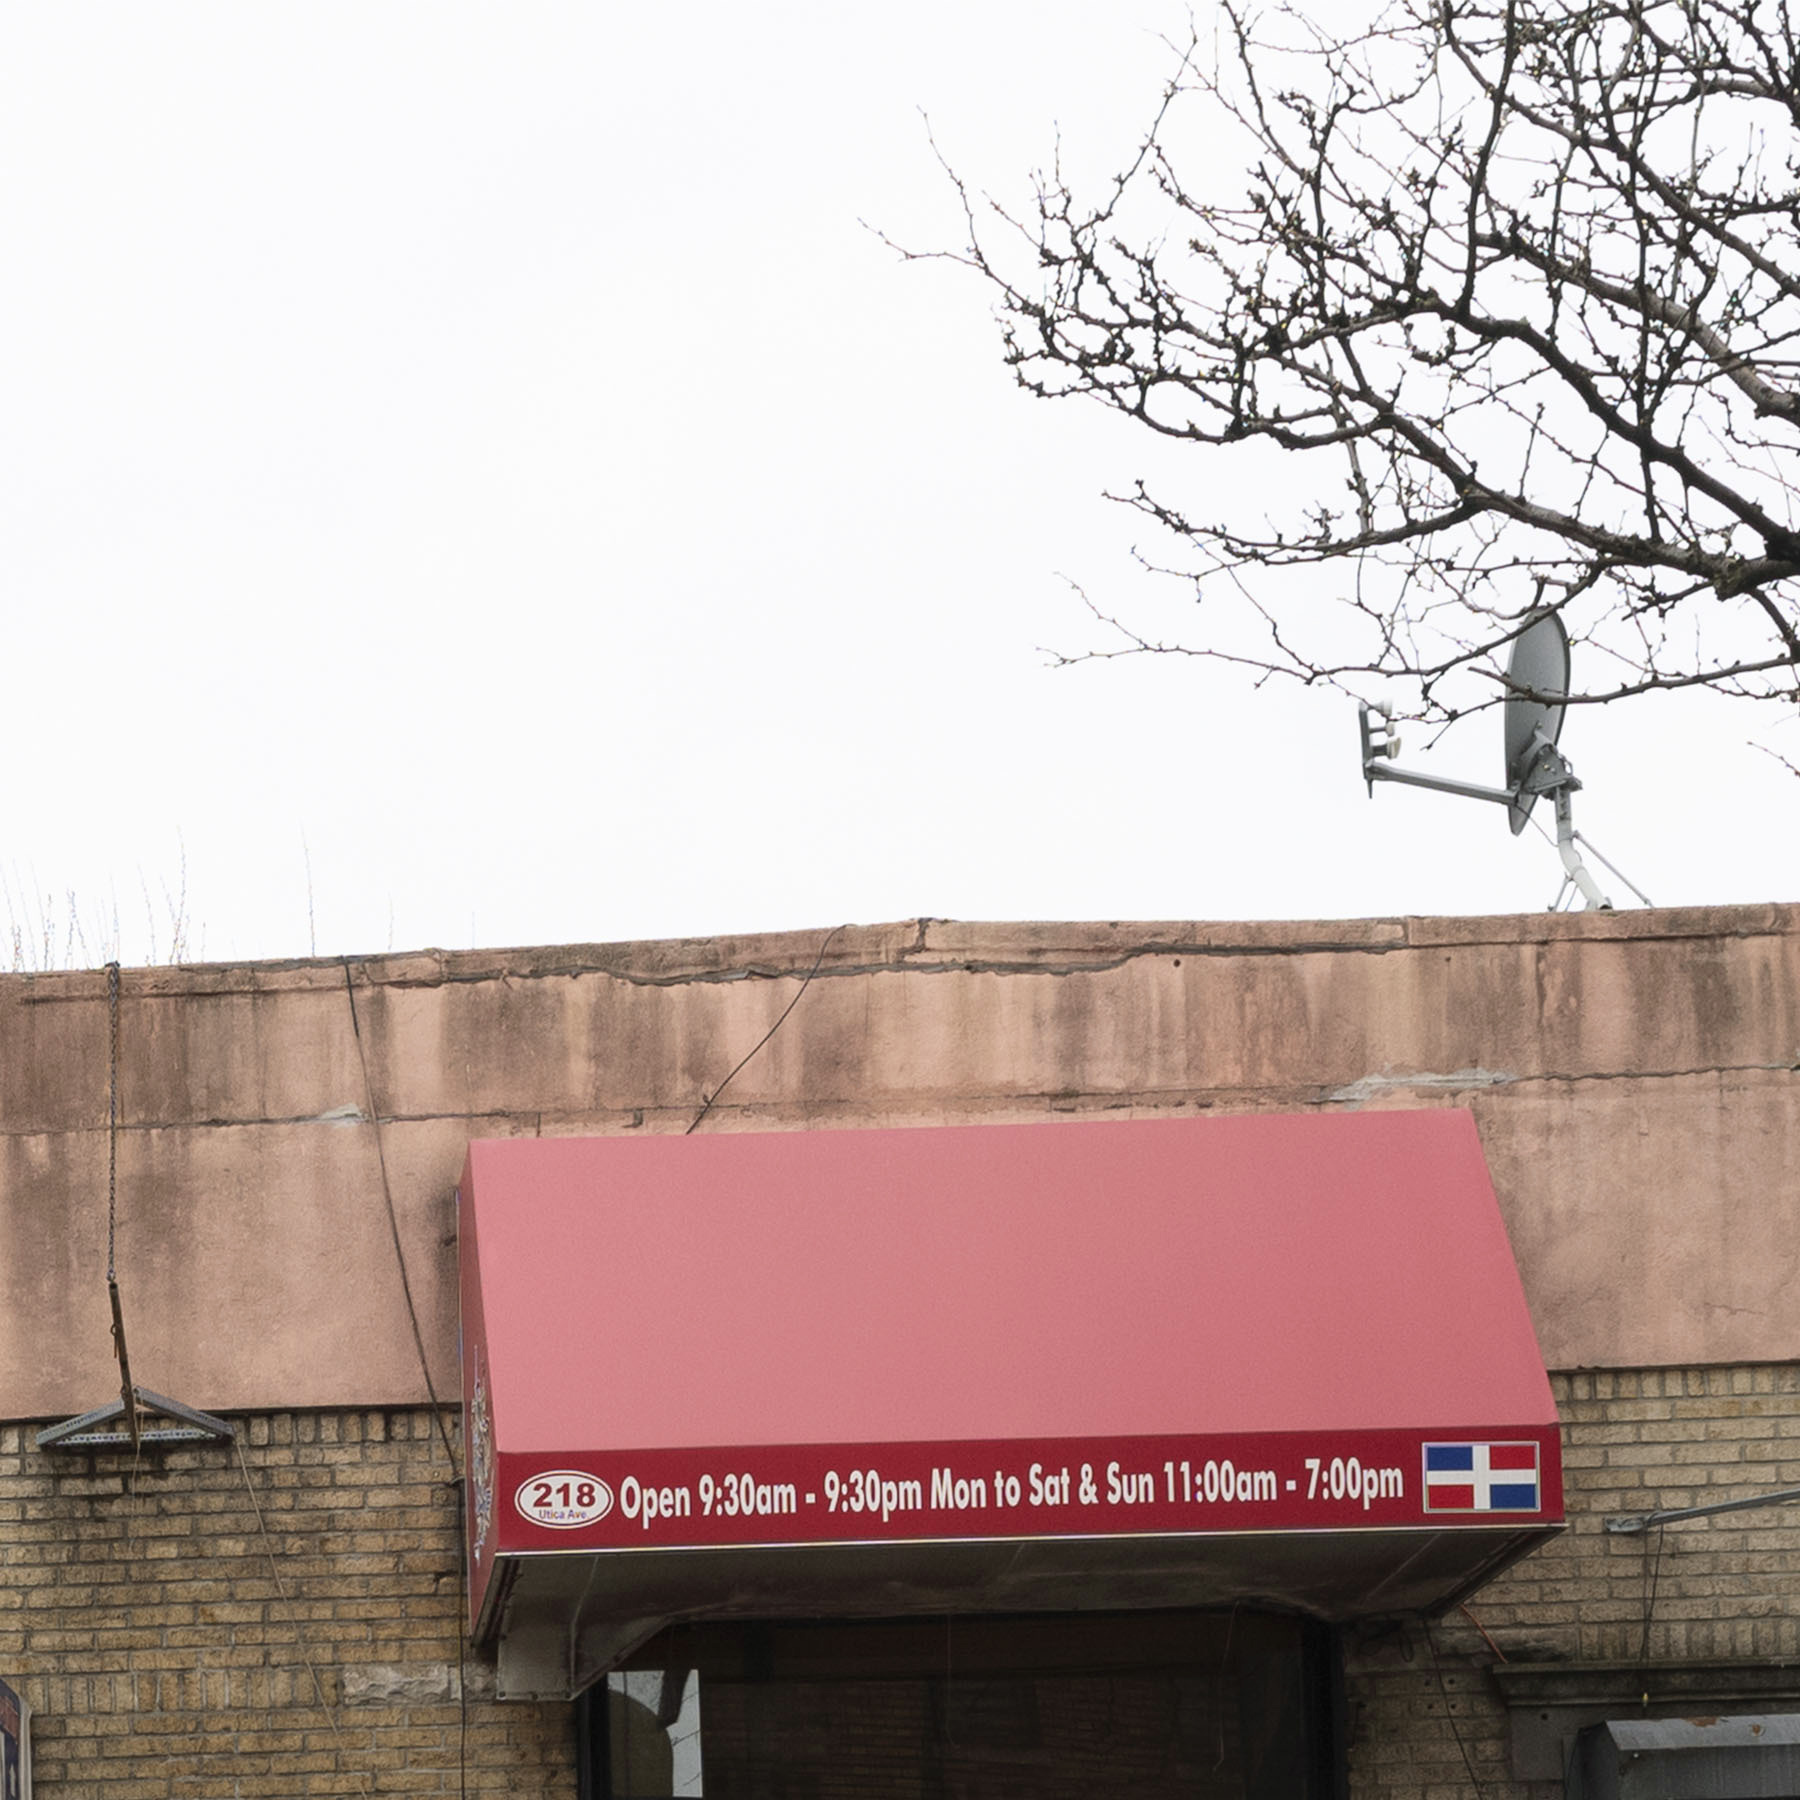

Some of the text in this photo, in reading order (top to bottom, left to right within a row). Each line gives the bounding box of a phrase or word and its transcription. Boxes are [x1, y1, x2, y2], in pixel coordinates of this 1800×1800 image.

[533, 1482, 597, 1508] 218
[621, 1455, 1405, 1530] Open 9:30am 9:30pm Mon to Sat & Sun 11:00am 7:00pm
[539, 1509, 565, 1520] Utica
